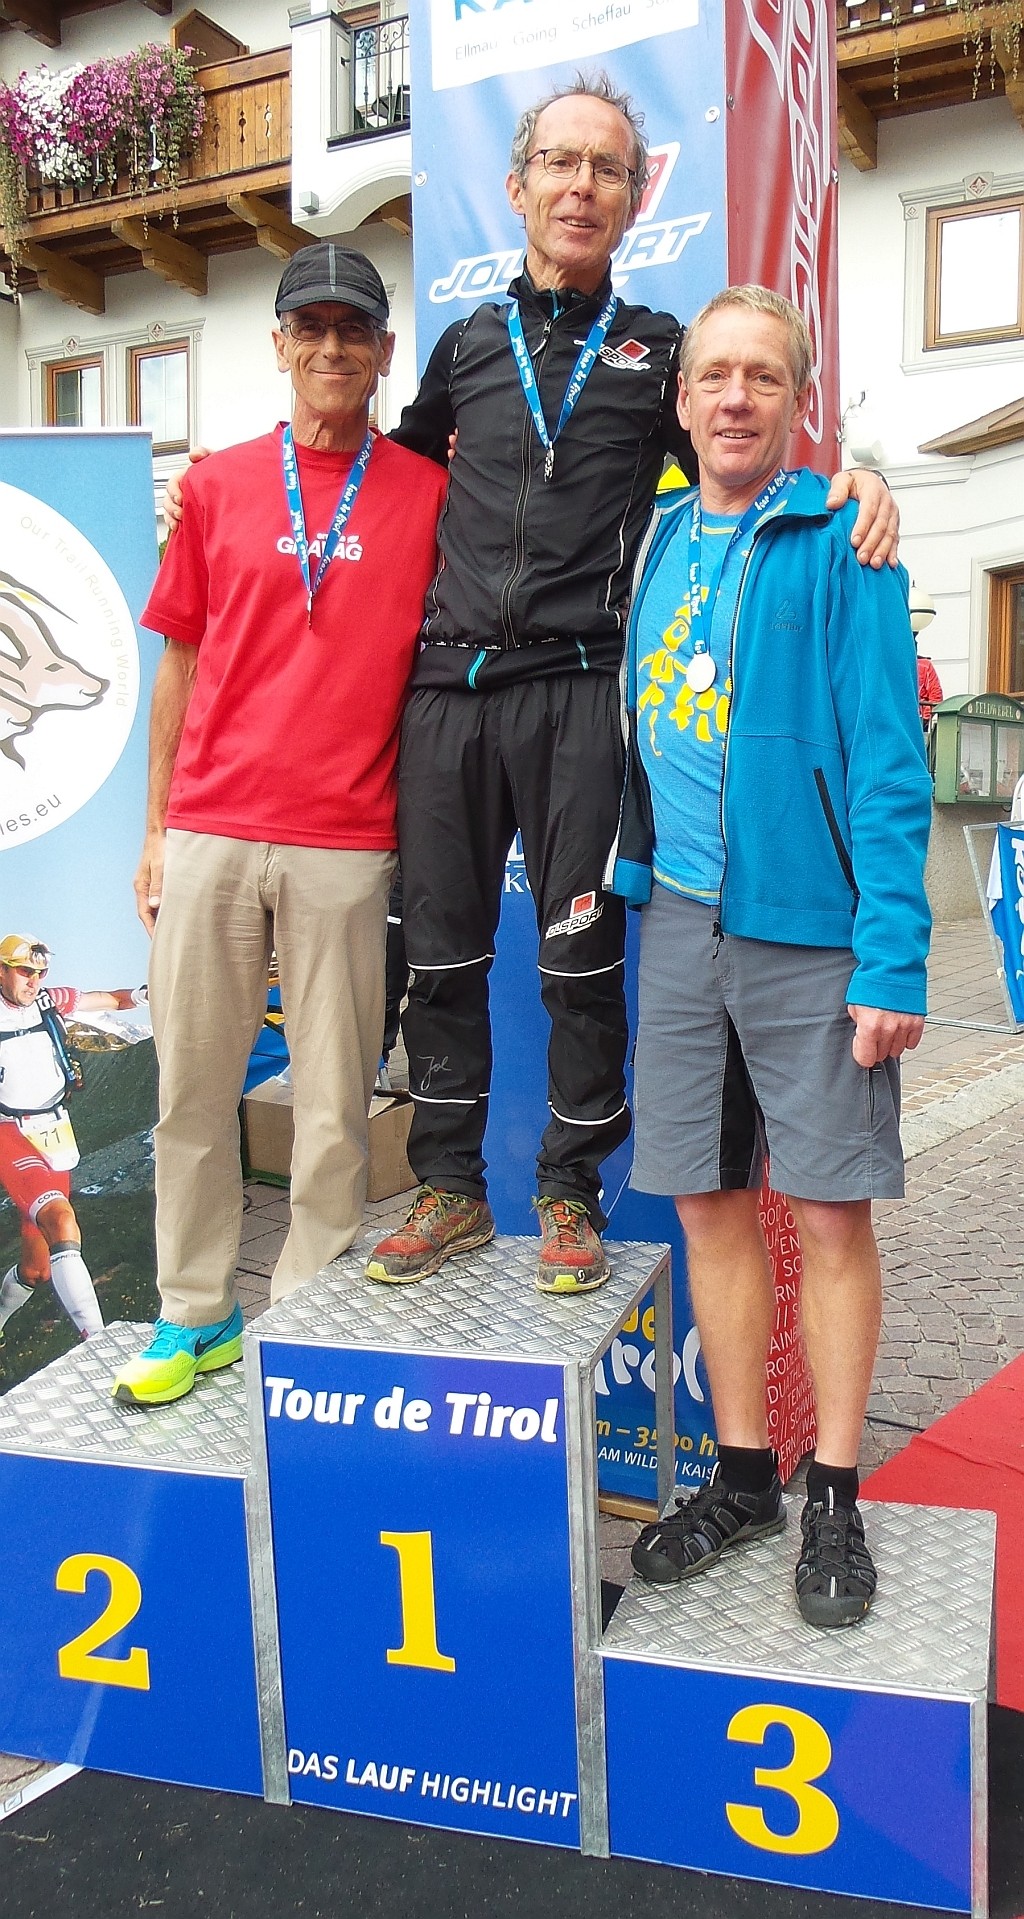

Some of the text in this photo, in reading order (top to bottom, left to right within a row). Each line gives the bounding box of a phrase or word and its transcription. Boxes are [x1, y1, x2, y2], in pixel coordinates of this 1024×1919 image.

[455, 3, 632, 61] Ellmau Going Scheffau
[20, 516, 129, 707] Our Trail Running World
[40, 1127, 61, 1148] 71
[264, 1375, 560, 1443] Tour de Tirol
[597, 1446, 621, 1463] AM
[624, 1450, 678, 1475] WILD
[54, 1552, 152, 1691] 2
[379, 1530, 457, 1673] 1
[287, 1748, 577, 1818] DAS LAUF HIGHLIGHT
[725, 1702, 841, 1856] 3
